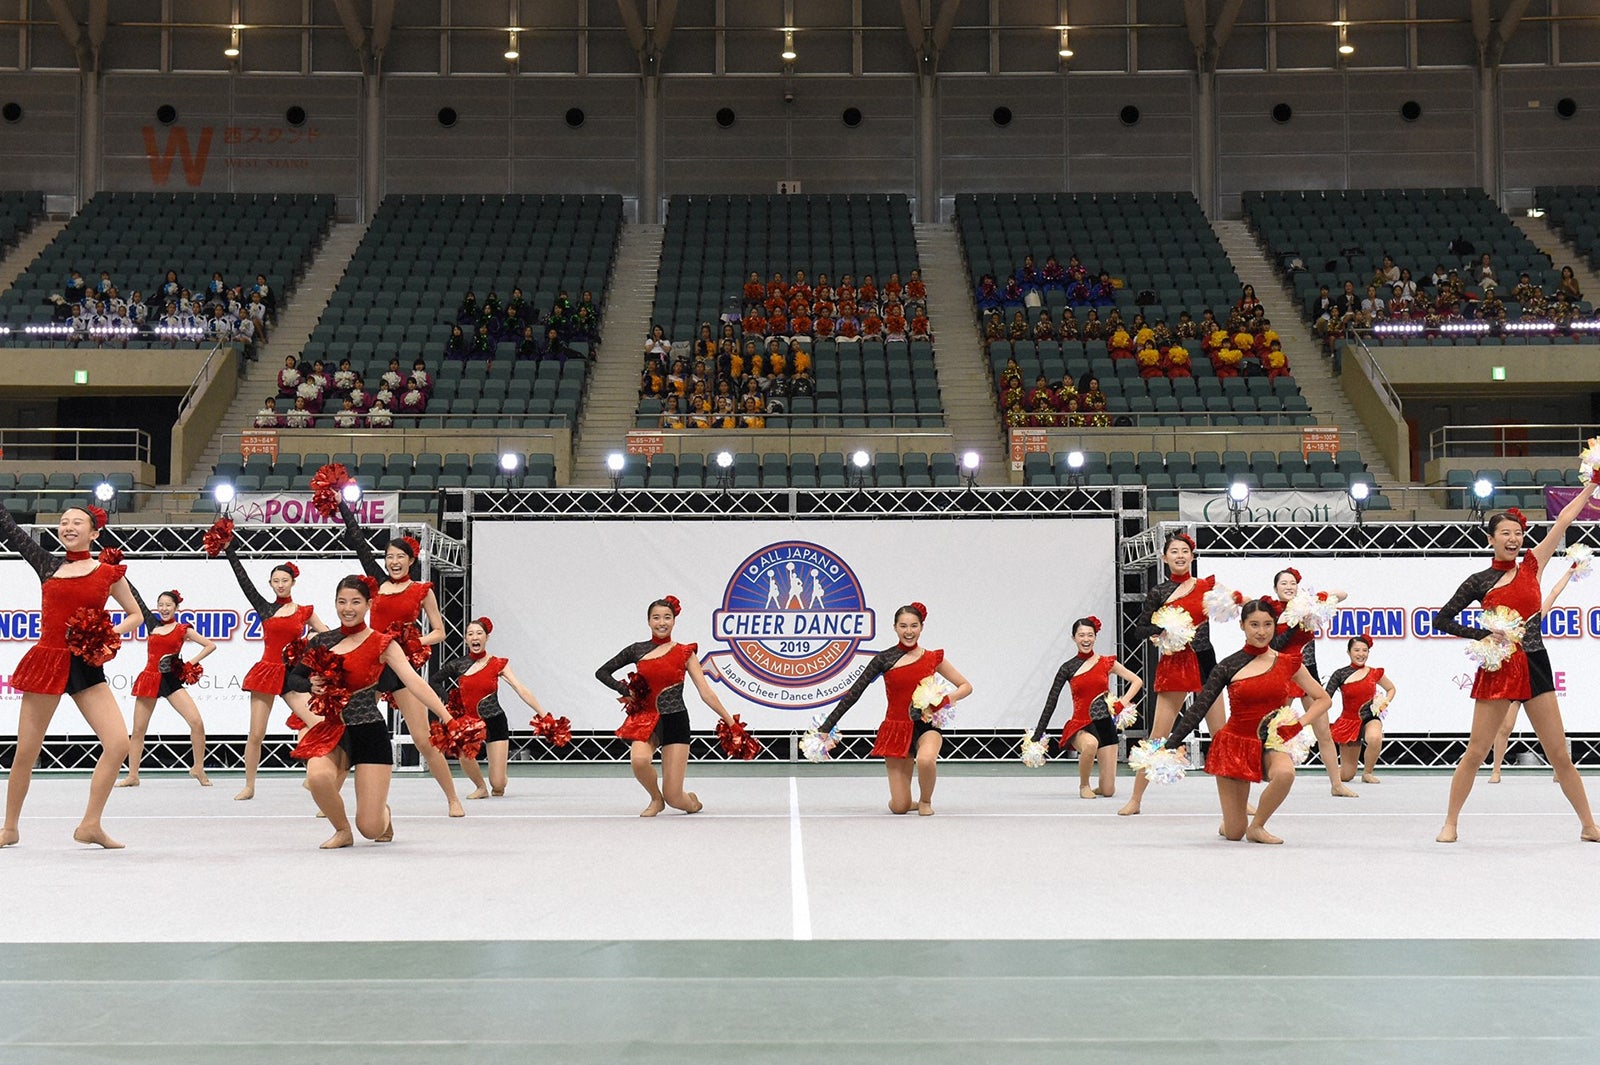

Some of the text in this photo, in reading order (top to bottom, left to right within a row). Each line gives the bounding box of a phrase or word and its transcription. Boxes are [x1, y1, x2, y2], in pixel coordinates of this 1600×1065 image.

[224, 127, 321, 144] 西スタンド
[142, 125, 214, 187] W
[224, 158, 308, 168] WEST STAND
[759, 547, 830, 569] ALL JAPAN
[722, 614, 864, 635] CHEER DANCE
[1330, 610, 1401, 636] JAPAN
[780, 641, 810, 653] 2019
[745, 642, 842, 675] CHAMPIONSHIP
[721, 663, 866, 701] Japan Cheer Dance Association
